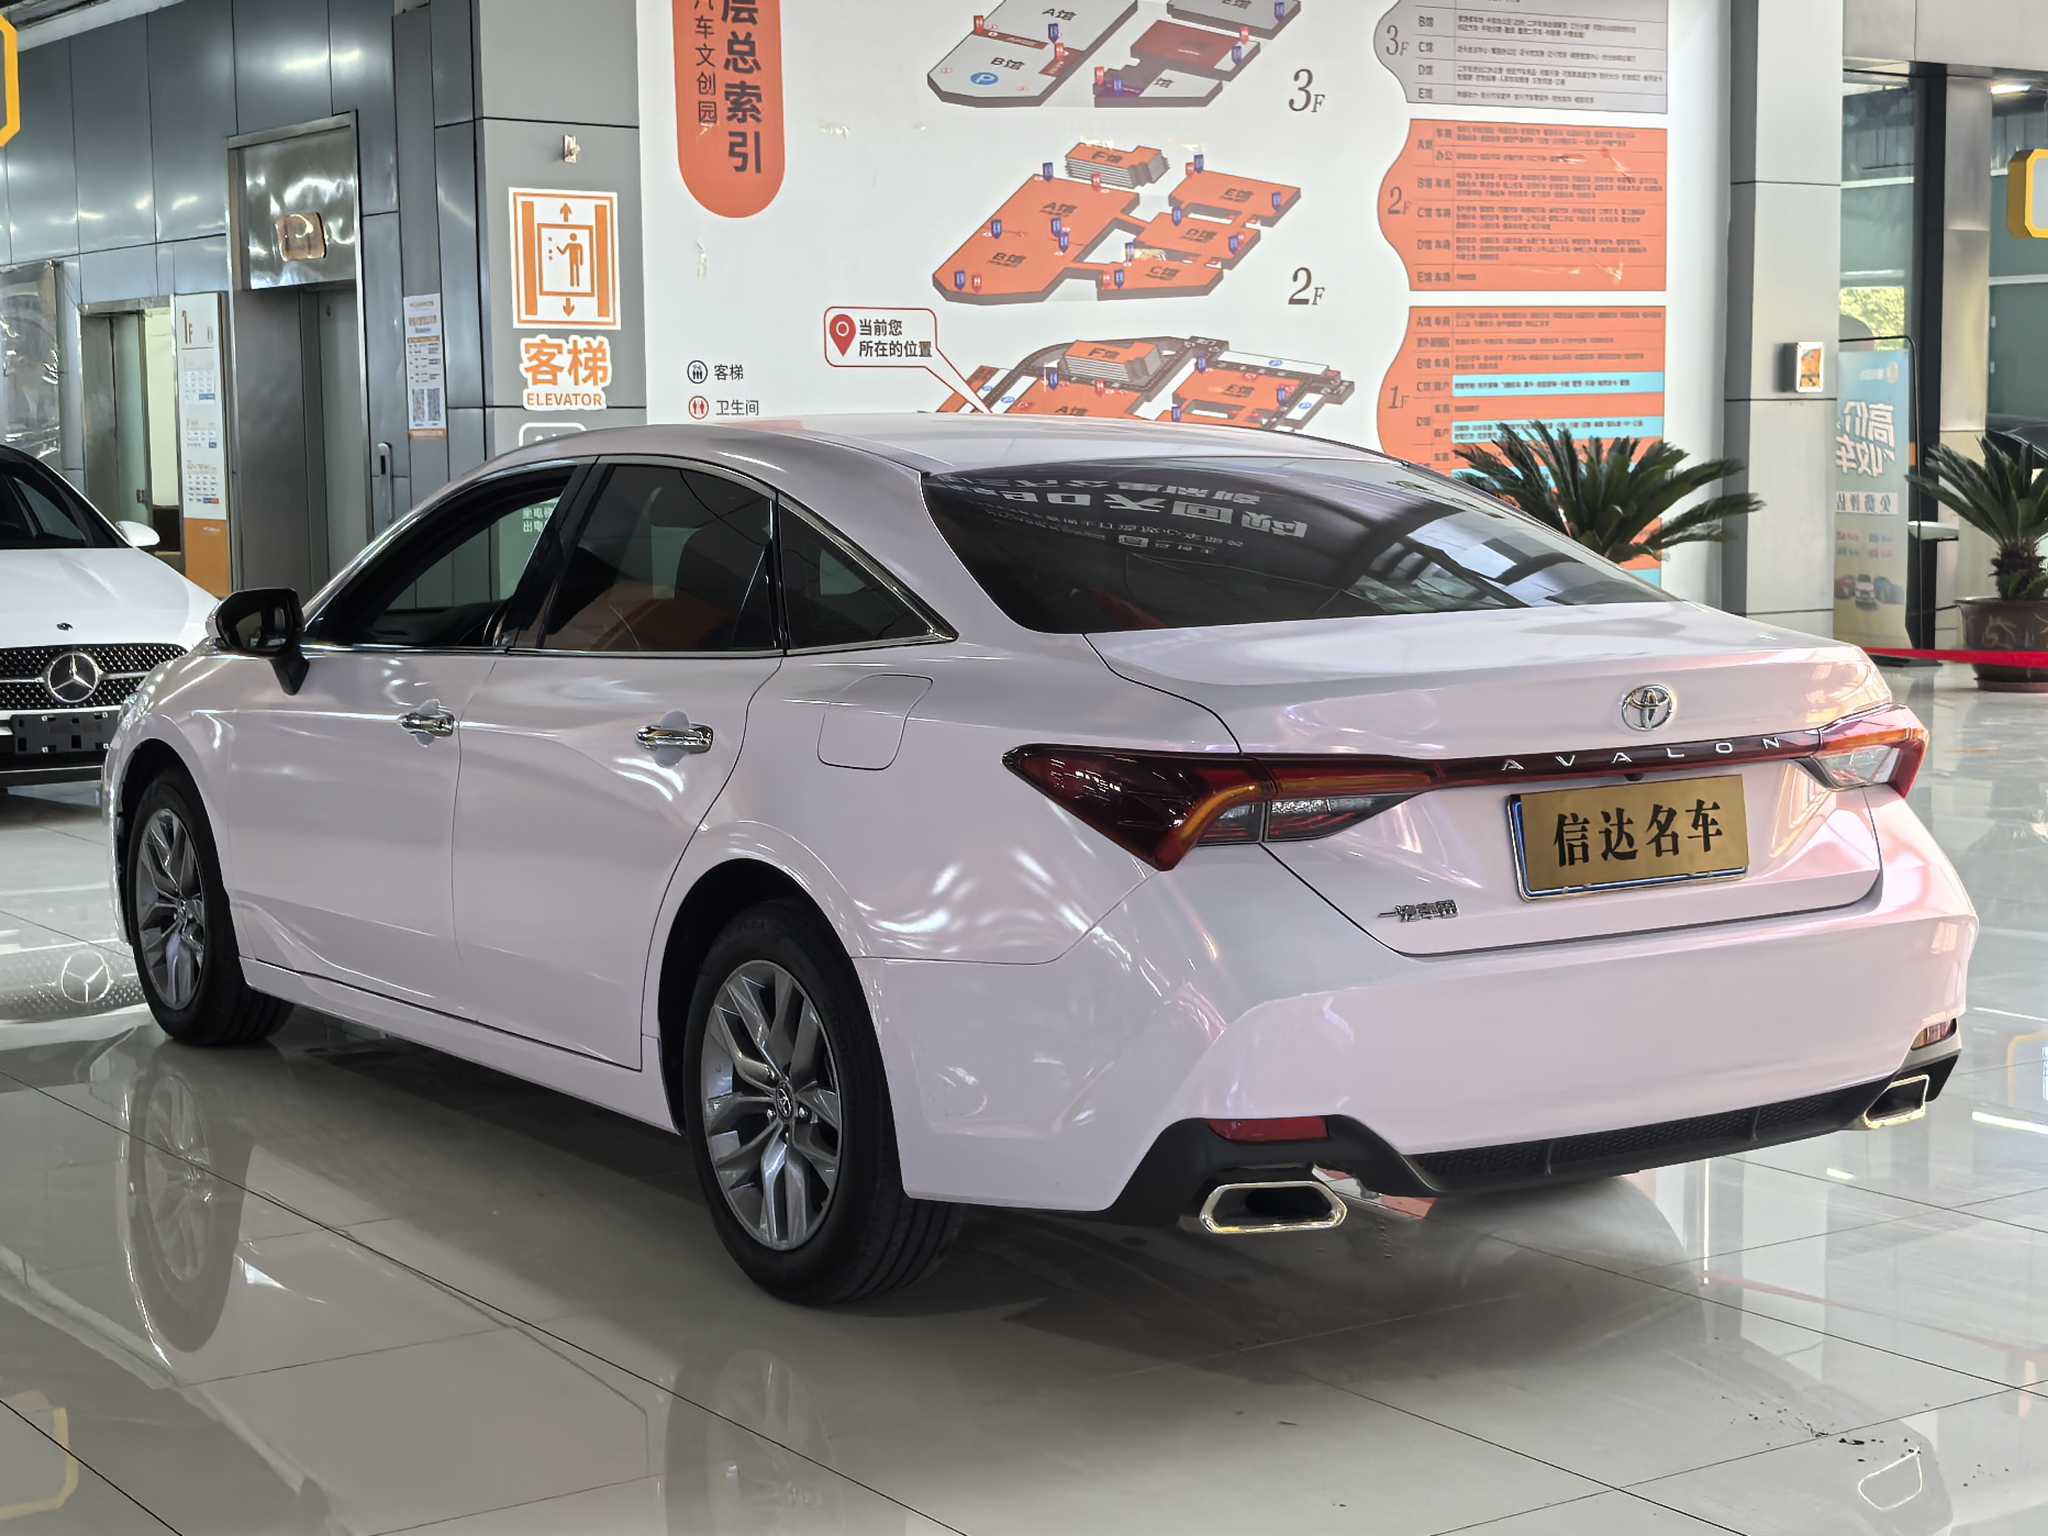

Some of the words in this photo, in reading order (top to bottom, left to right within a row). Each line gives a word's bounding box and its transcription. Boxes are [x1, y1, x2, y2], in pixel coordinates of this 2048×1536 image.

[859, 319, 903, 336] 当前您
[858, 341, 933, 358] 所在的位置
[524, 339, 609, 386] 客梯
[714, 364, 744, 380] 客梯
[526, 392, 603, 406] ELEVATOR
[715, 400, 759, 416] 卫生间
[1500, 735, 1781, 772] AVALON
[1553, 798, 1724, 868] 信达名车
